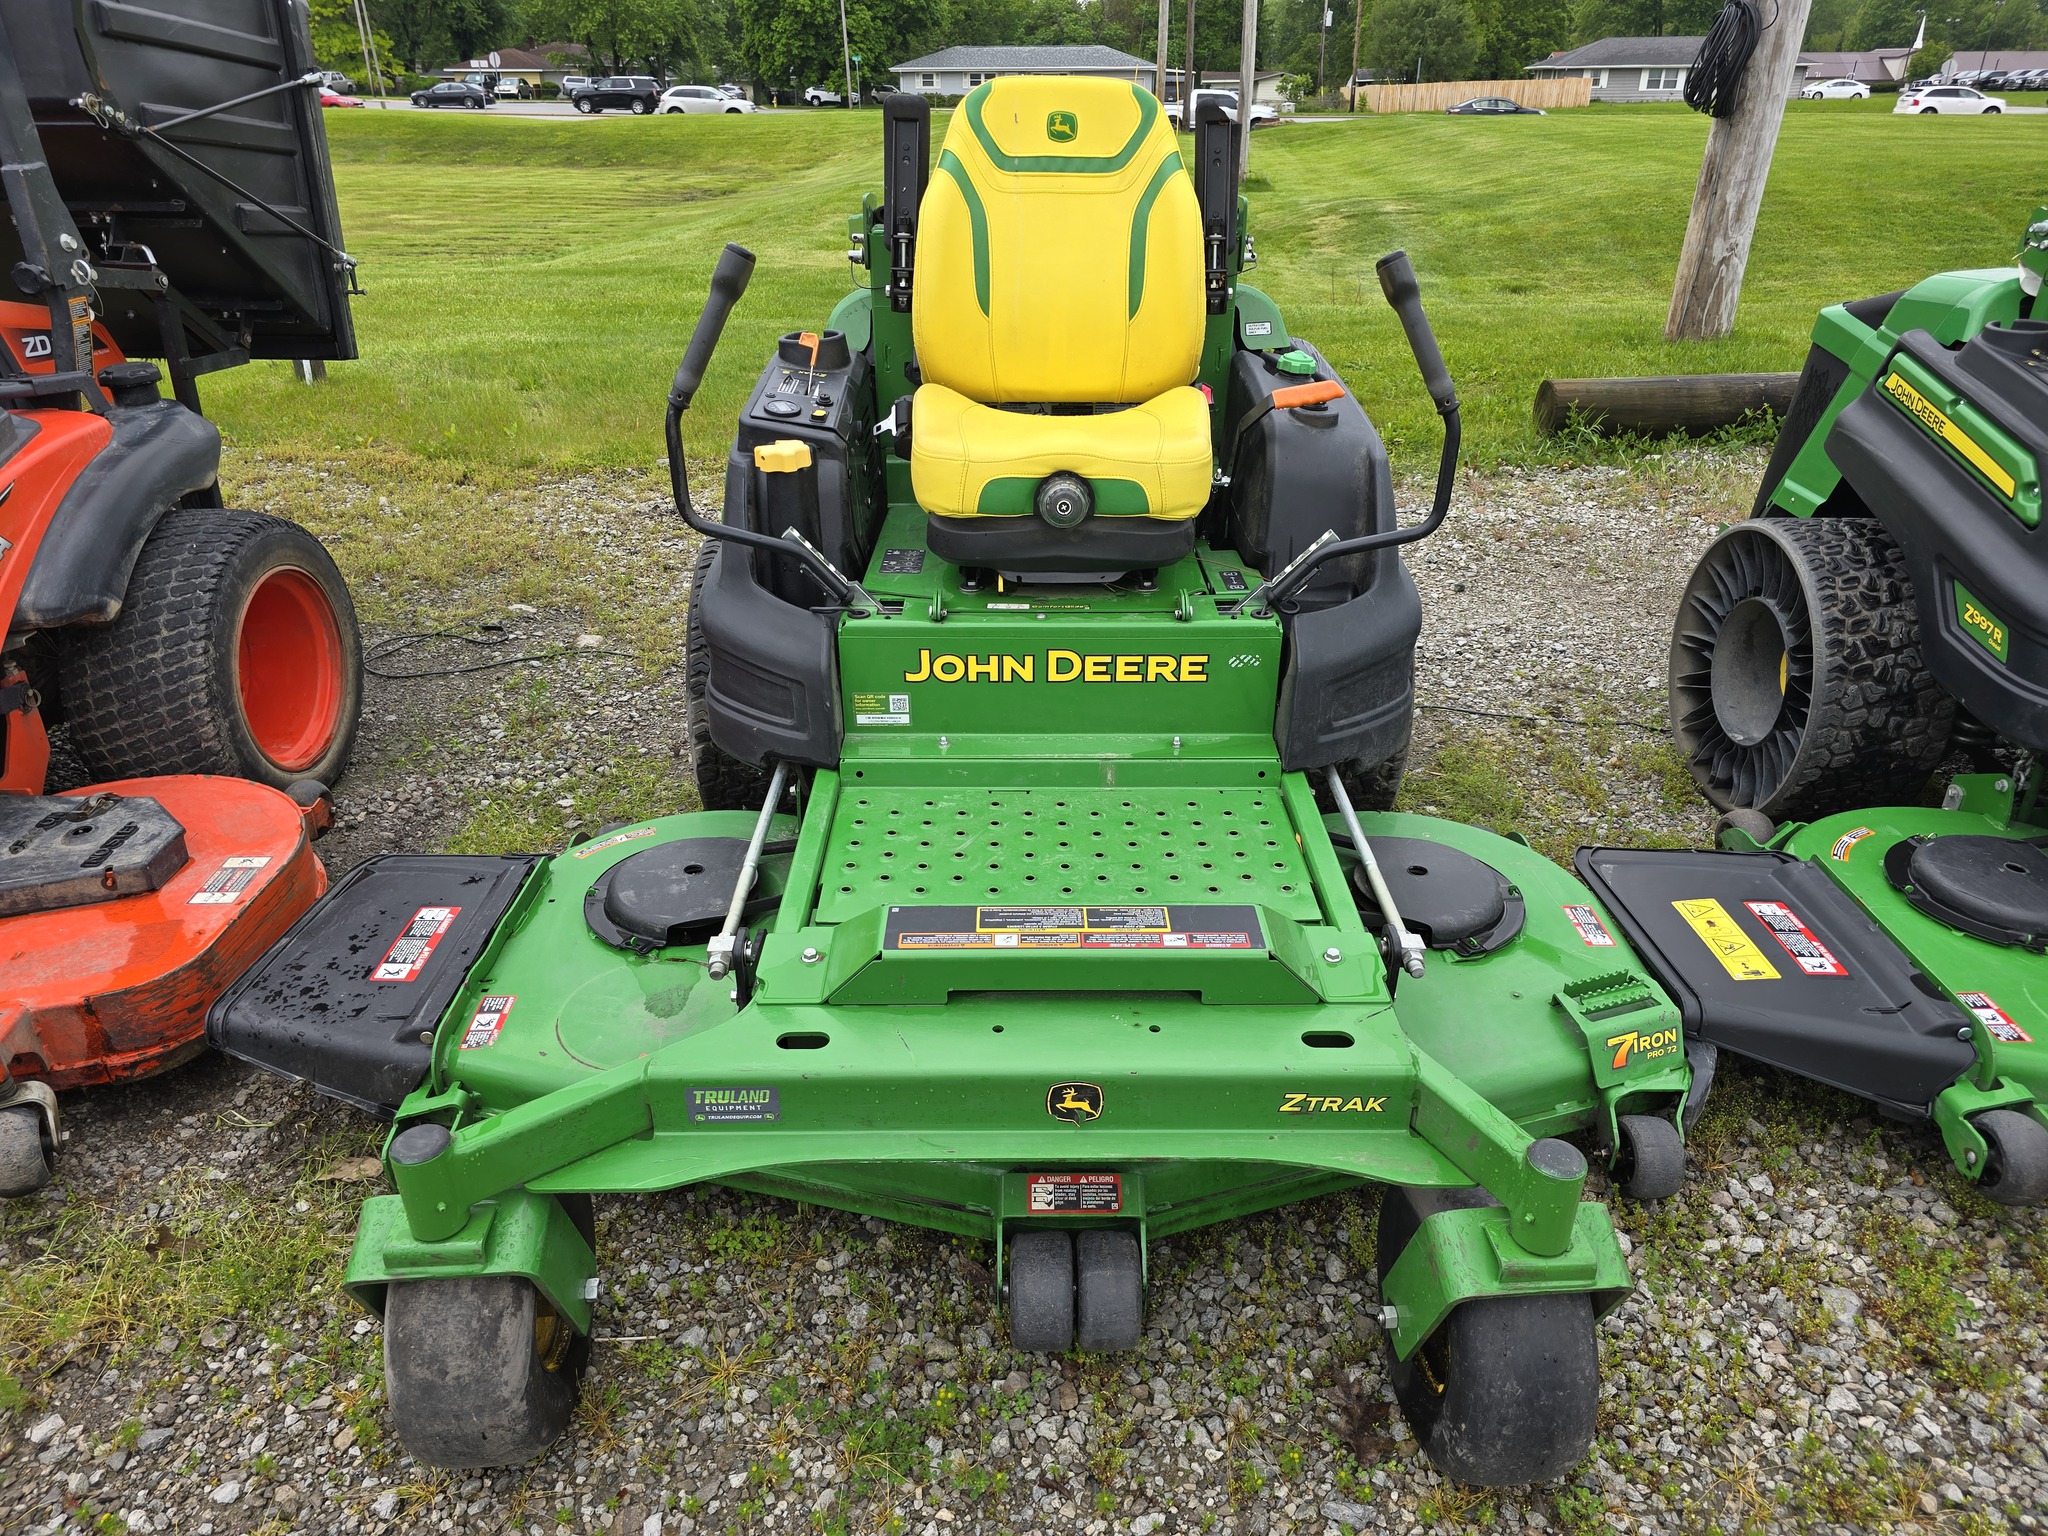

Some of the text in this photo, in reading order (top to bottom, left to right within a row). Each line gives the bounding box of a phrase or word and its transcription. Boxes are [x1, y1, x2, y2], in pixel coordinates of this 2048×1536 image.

[21, 334, 52, 358] ZD
[1889, 379, 1947, 436] JOHN DEERE
[1963, 602, 2003, 644] Z997R
[1988, 637, 2002, 652] Diesel
[904, 648, 1211, 684] JOHN DEERE
[1647, 1045, 1678, 1060] PRO 72
[693, 1089, 771, 1105] TRULAND
[1277, 1093, 1391, 1112] ZTRAK
[705, 1104, 762, 1112] EQUIPMENT
